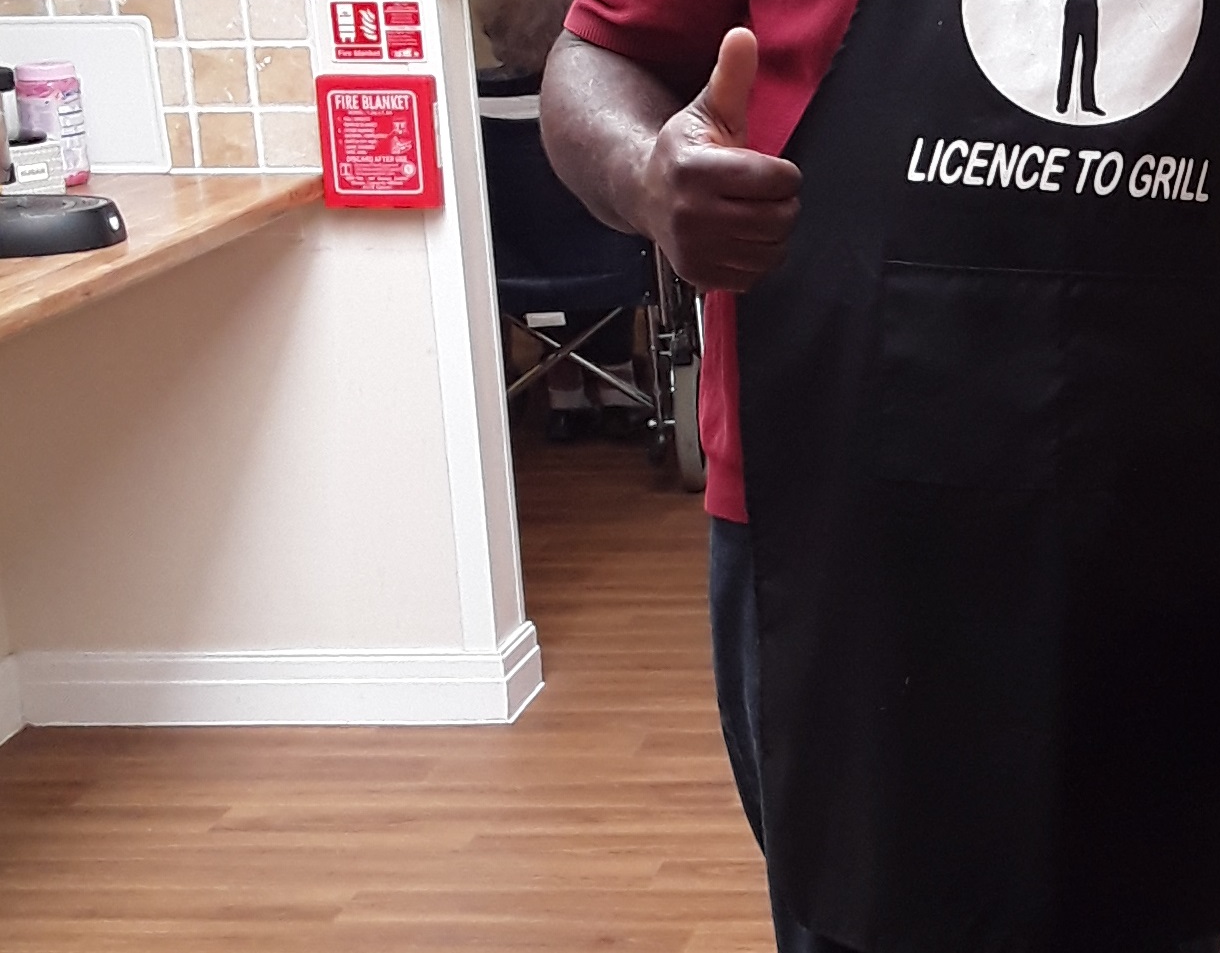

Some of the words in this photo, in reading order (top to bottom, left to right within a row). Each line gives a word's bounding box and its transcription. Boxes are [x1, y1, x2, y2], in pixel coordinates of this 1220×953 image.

[334, 95, 359, 110] FIRE
[362, 94, 410, 110] BLANKET
[907, 137, 1070, 192] LICENCE
[1075, 150, 1124, 196] TO
[1128, 154, 1209, 202] GRILL
